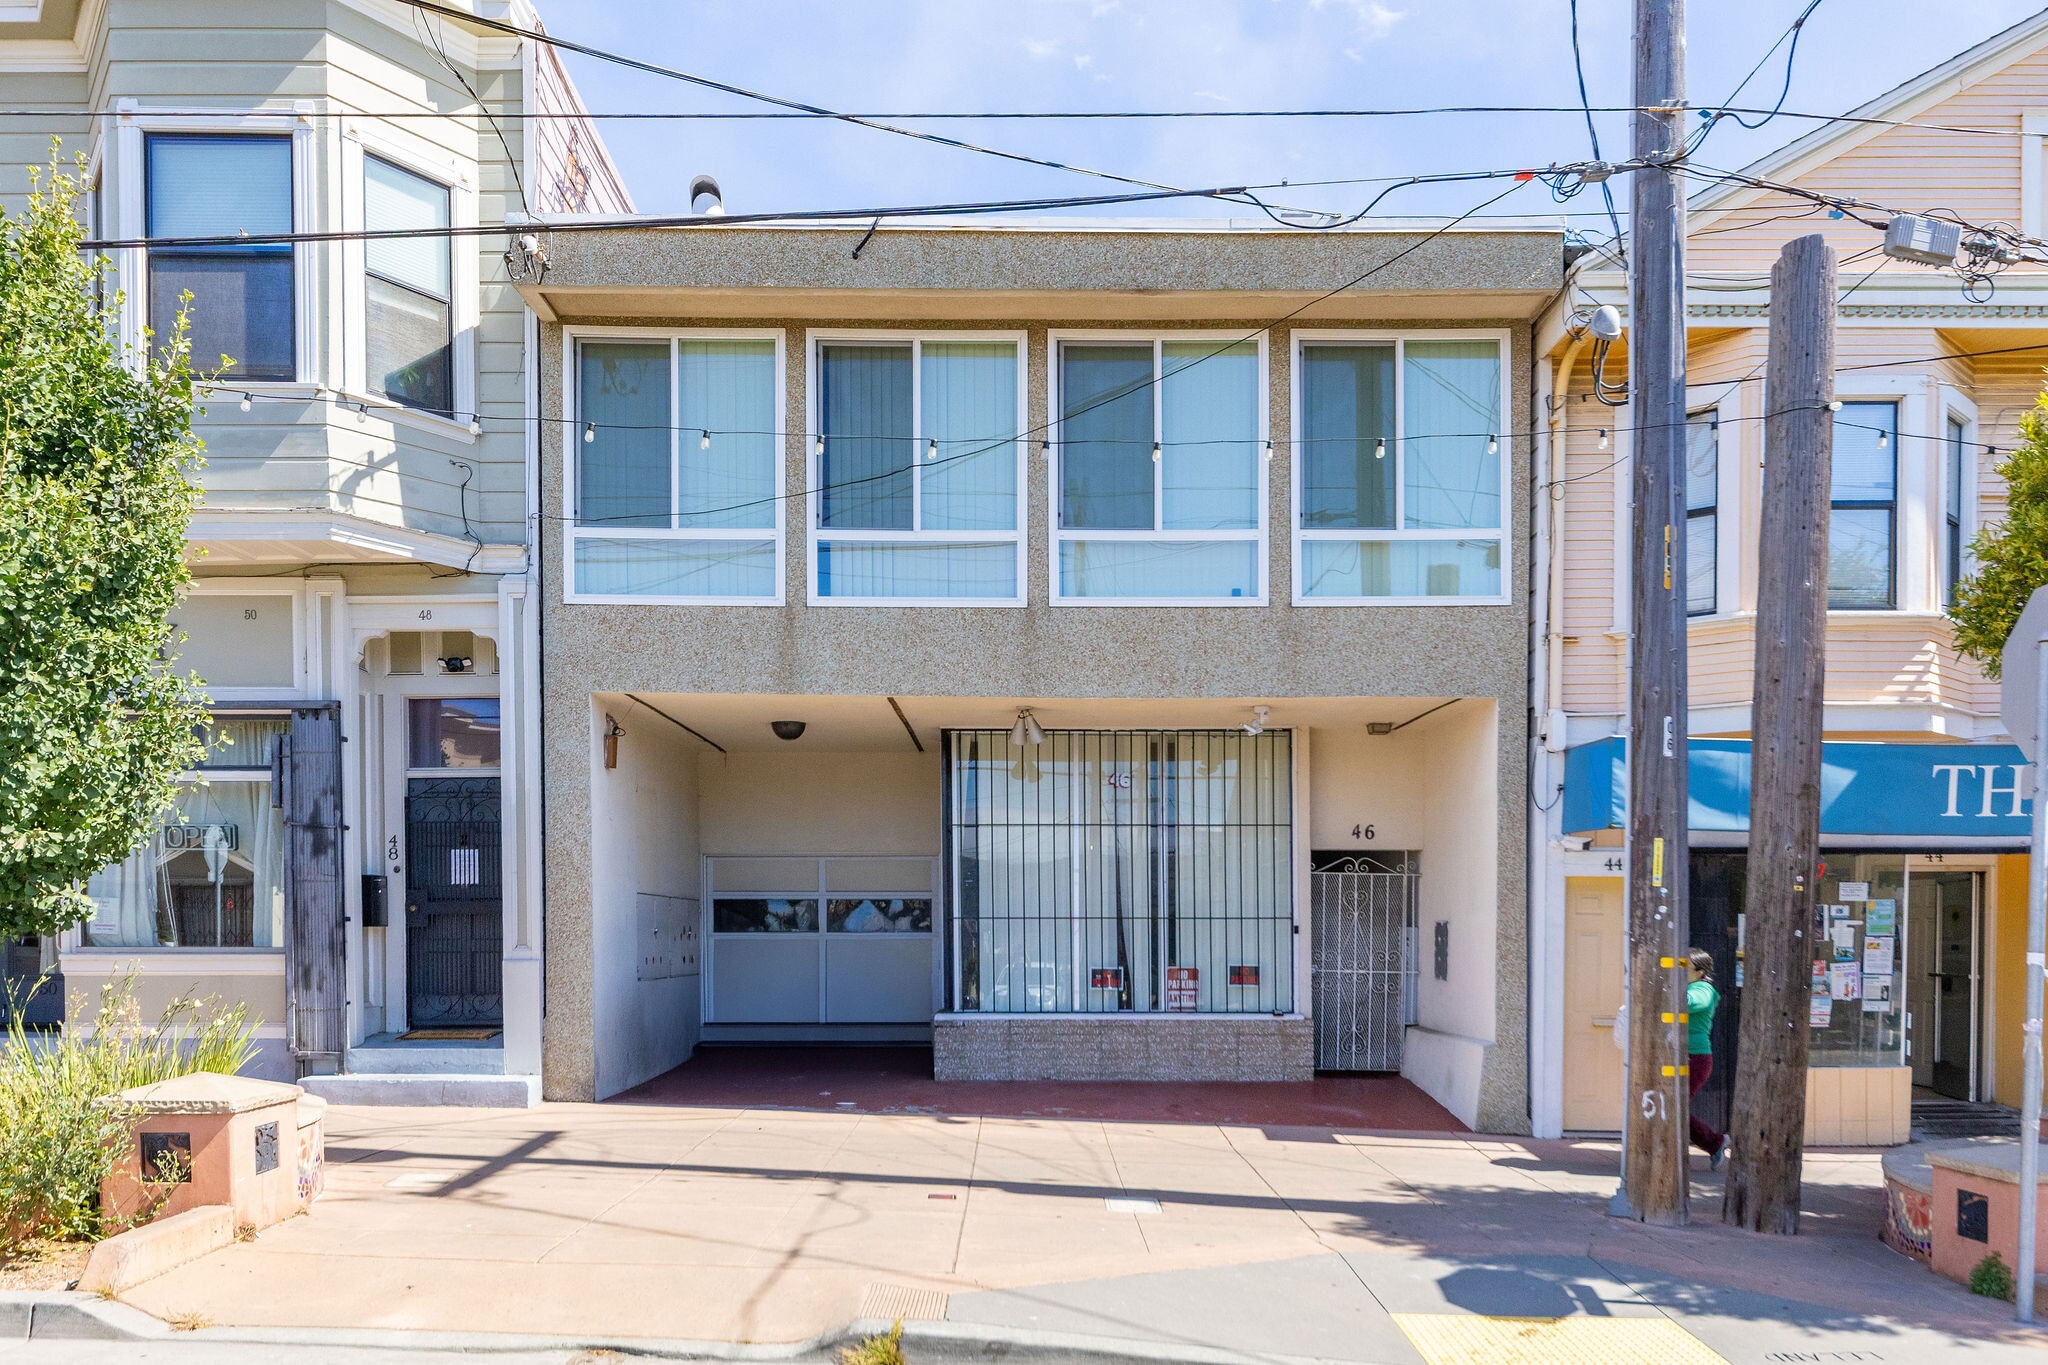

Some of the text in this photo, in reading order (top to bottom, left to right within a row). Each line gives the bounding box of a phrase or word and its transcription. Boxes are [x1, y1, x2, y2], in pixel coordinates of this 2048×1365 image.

[244, 609, 257, 620] 50
[418, 609, 432, 620] 48
[1107, 771, 1131, 789] 46
[1931, 764, 2034, 817] TH
[1351, 823, 1375, 840] 46
[388, 834, 399, 861] 48
[1604, 857, 1623, 871] 44
[1177, 969, 1189, 980] NO
[1641, 1090, 1667, 1121] 51
